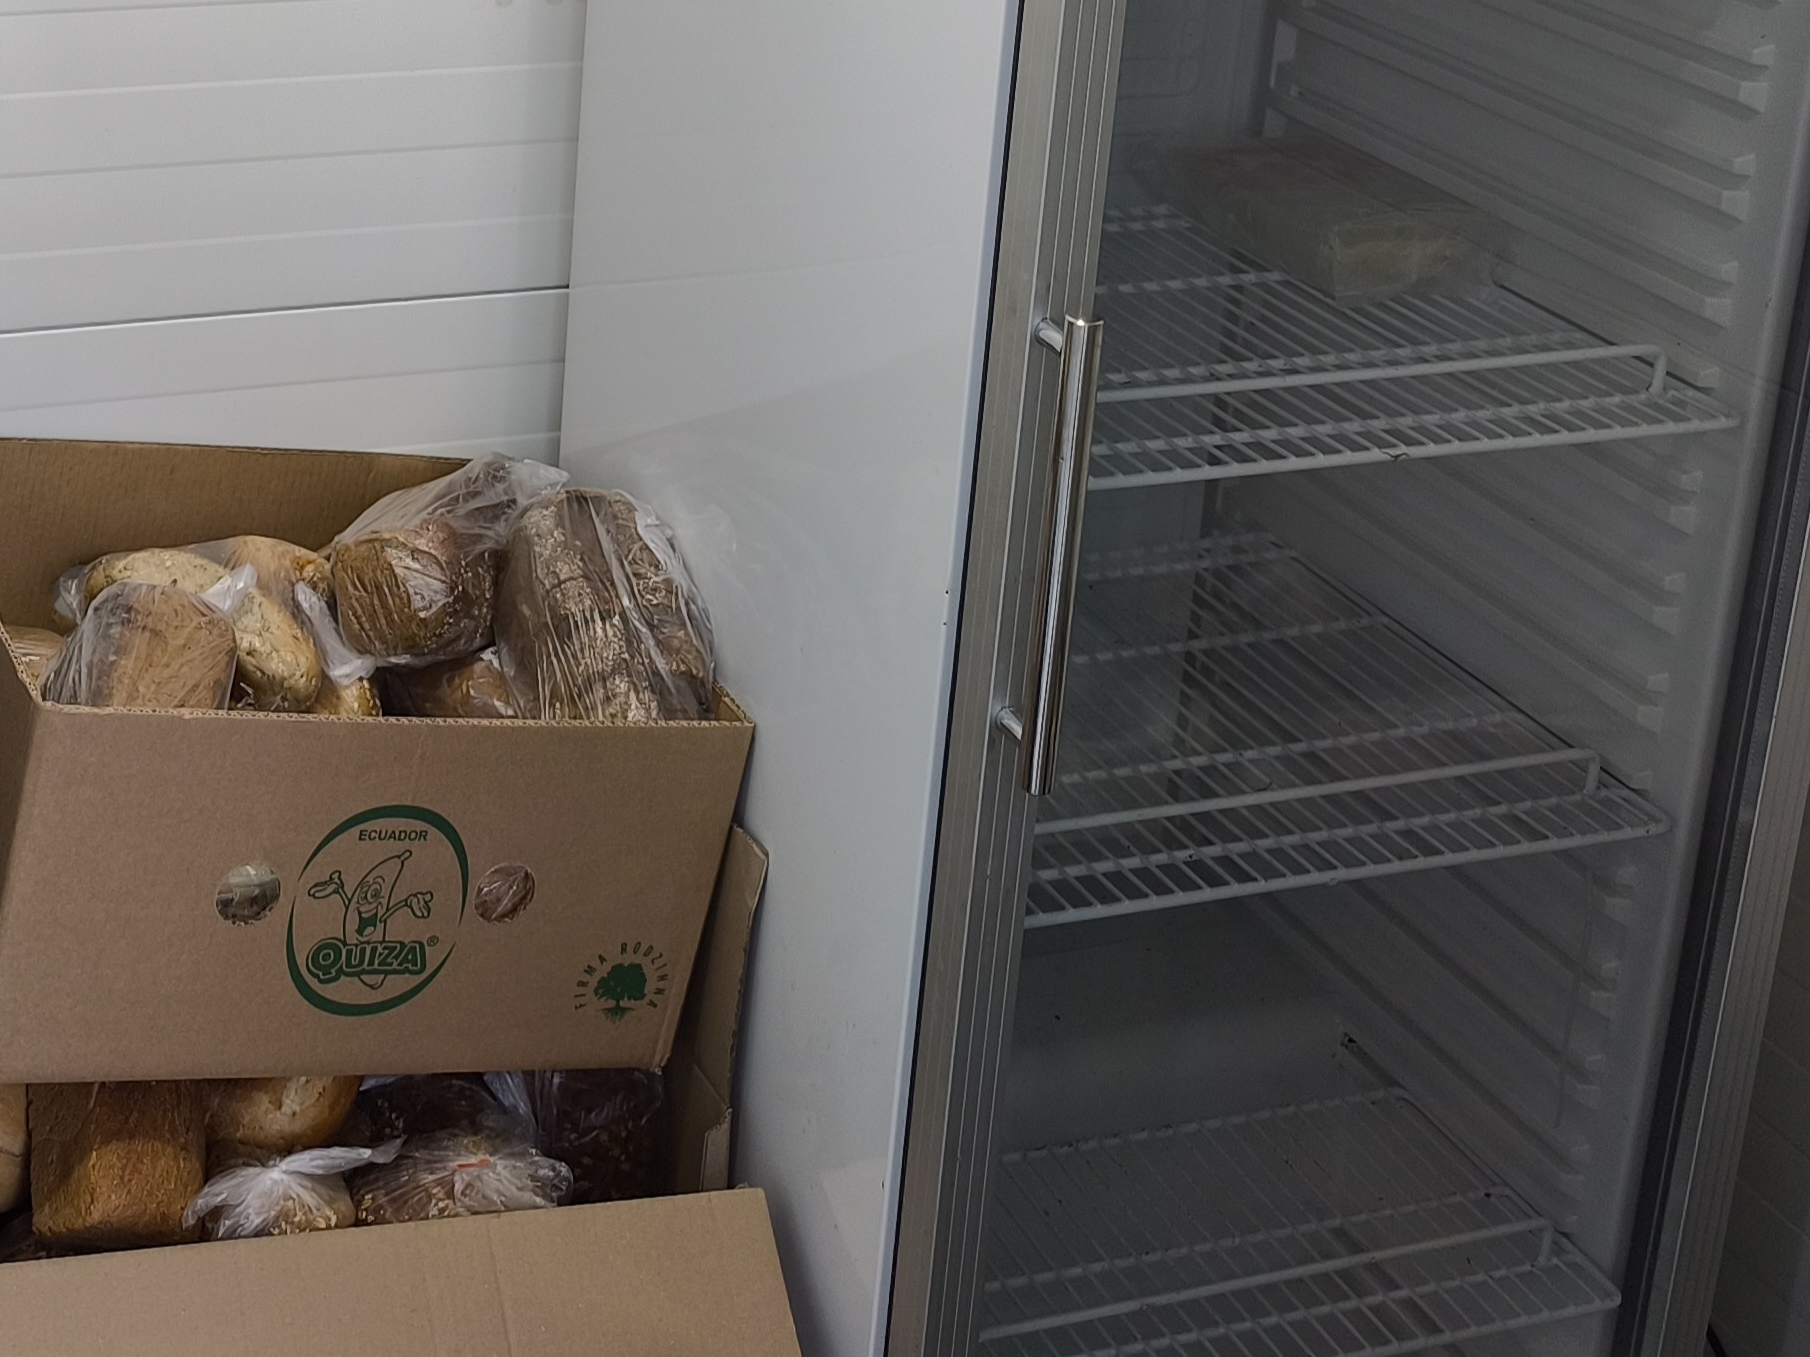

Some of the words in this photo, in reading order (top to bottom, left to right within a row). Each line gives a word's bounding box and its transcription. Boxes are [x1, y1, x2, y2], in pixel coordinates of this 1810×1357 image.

[358, 829, 429, 842] ECUADOR
[307, 938, 427, 984] QUIZA
[573, 953, 608, 1011] FIRMA
[620, 941, 669, 1009] RODZINNA
